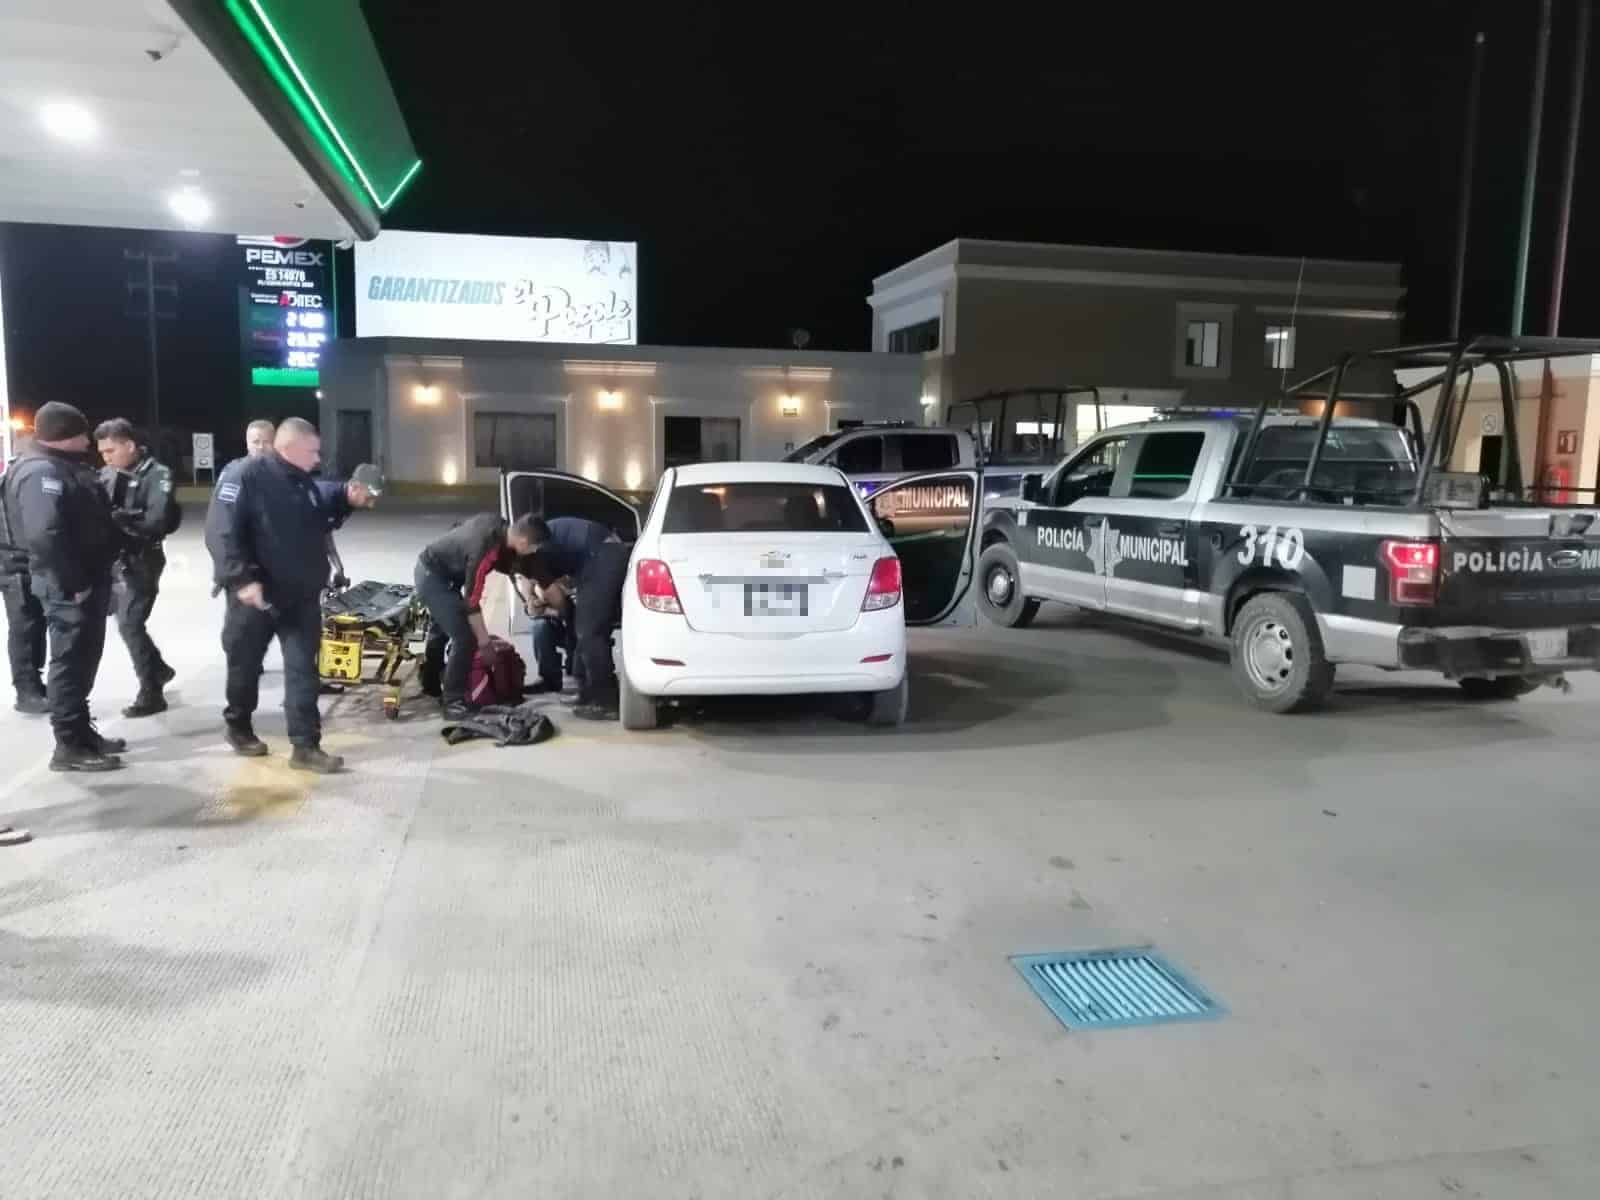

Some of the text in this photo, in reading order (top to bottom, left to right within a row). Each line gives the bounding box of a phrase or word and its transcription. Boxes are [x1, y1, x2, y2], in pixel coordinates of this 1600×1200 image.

[246, 248, 324, 266] PEMEX
[368, 275, 506, 305] GARANTIZADOS
[902, 486, 969, 508] MUNICIPAL
[1120, 534, 1189, 567] MUNICIPAL
[1237, 524, 1304, 570] 310
